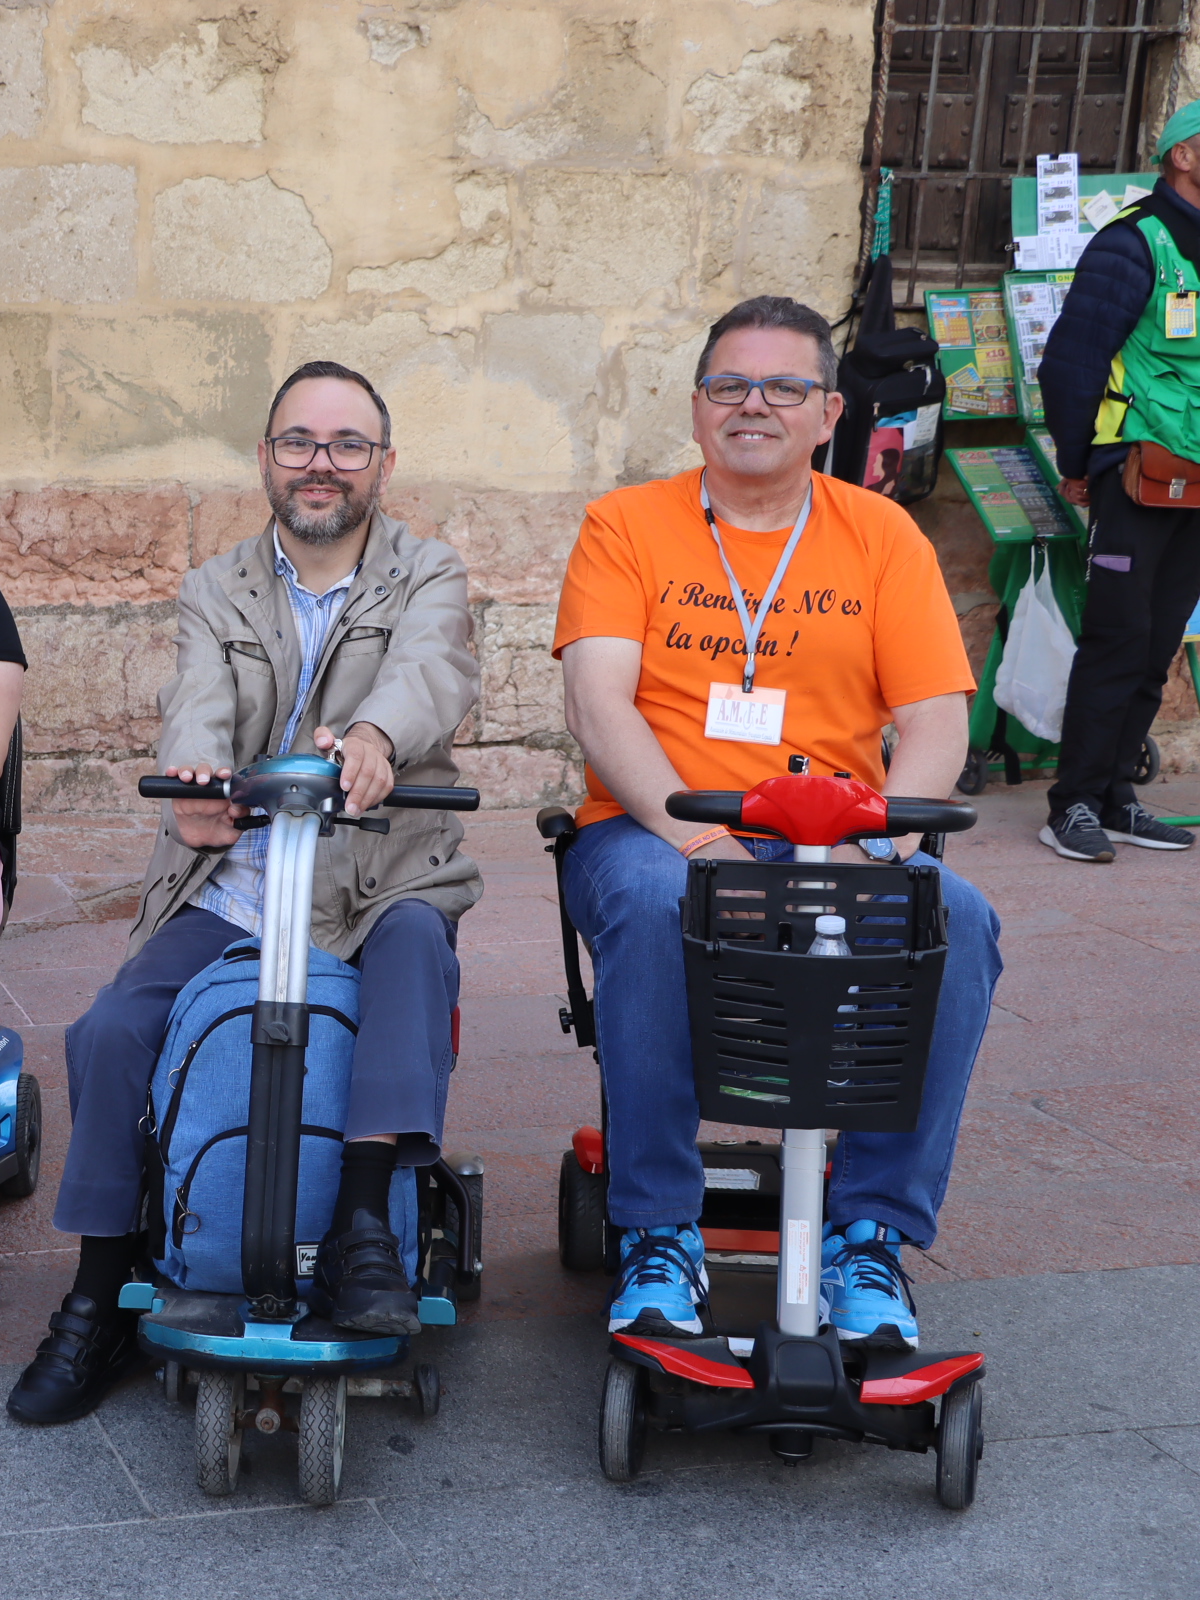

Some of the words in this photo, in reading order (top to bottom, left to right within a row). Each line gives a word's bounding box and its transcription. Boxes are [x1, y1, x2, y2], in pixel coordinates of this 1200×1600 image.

[793, 588, 837, 615] NO
[841, 598, 862, 616] es
[666, 621, 692, 650] la
